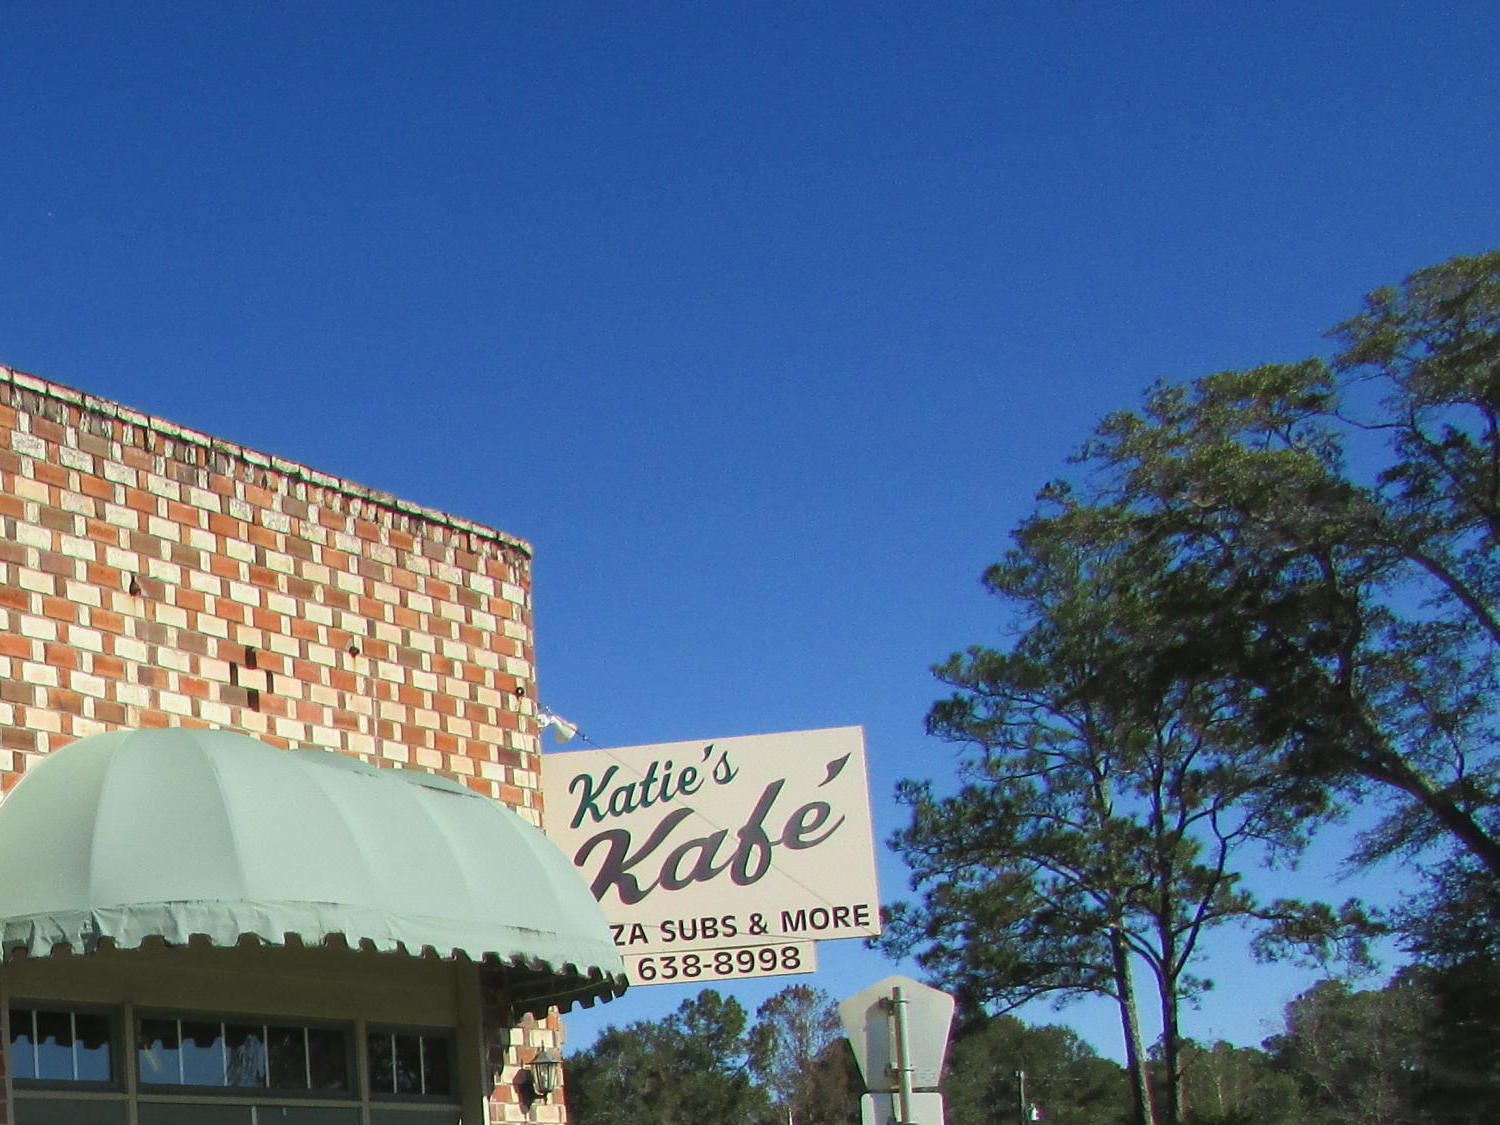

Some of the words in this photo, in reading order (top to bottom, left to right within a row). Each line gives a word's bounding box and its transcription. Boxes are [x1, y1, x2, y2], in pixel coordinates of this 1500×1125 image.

[569, 744, 739, 829] Katie's
[574, 752, 852, 905] Kafé
[661, 914, 737, 943] SUBS
[748, 912, 768, 935] &
[781, 904, 870, 932] MORE
[638, 946, 801, 981] 638-8998
